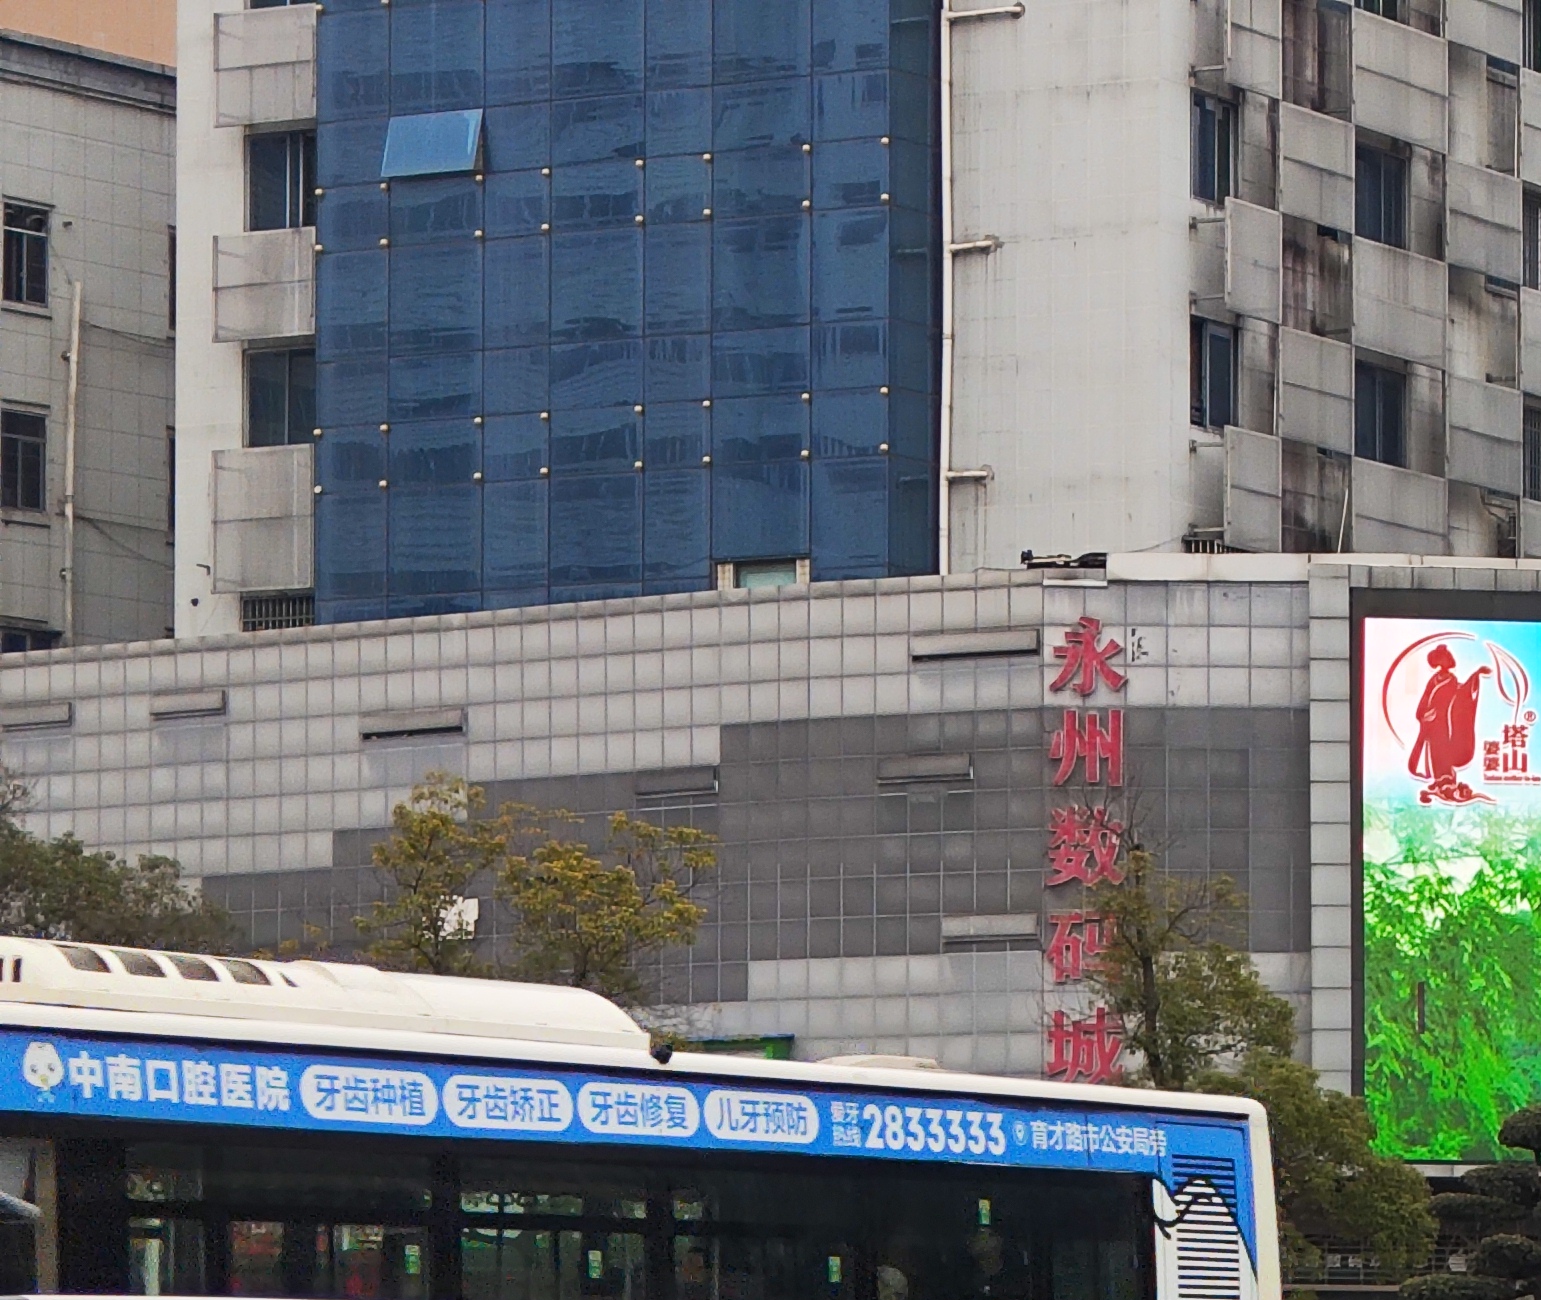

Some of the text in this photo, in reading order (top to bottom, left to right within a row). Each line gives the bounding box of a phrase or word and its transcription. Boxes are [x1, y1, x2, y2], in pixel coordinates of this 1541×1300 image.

[1048, 616, 1127, 1084] 永州数码城
[69, 1052, 809, 1137] 中南口腔医院 牙齿种植 牙齿矫正 牙齿修复 儿牙预防
[863, 1104, 1007, 1156] 2833333
[1030, 1120, 1167, 1158] 育才路市公安局旁
